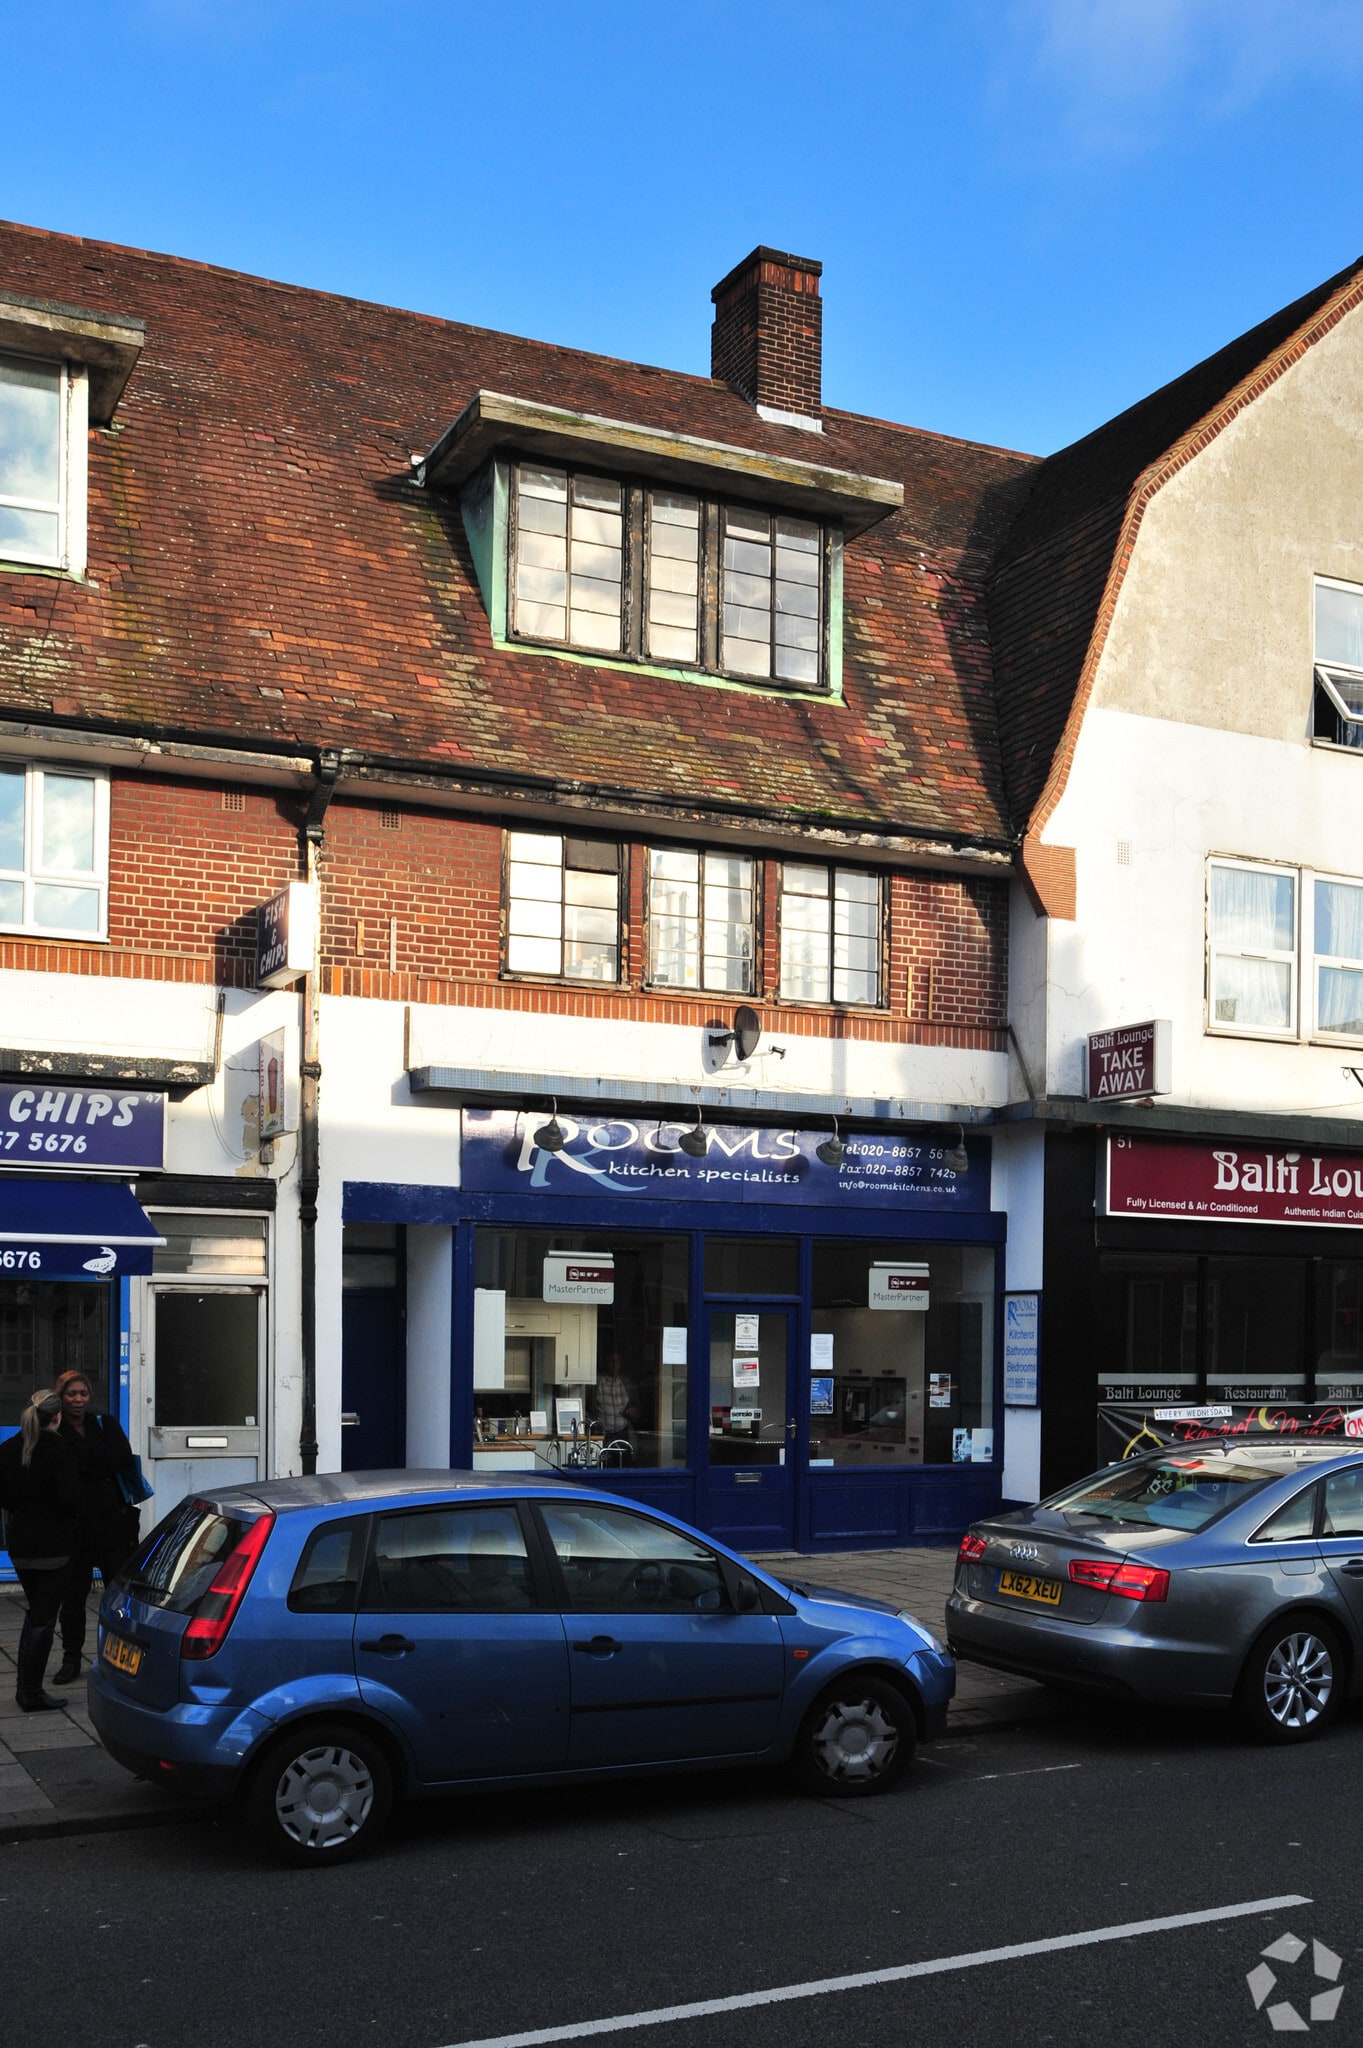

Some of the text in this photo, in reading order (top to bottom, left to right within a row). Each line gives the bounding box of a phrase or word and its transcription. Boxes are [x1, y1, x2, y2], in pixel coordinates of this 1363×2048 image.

[265, 896, 286, 928] FISH
[271, 928, 277, 946] &
[260, 939, 287, 975] CHIPS
[1091, 1028, 1154, 1050] Balti Lounge
[1101, 1047, 1144, 1073] TAKE
[1098, 1068, 1146, 1096] AWAY
[146, 1094, 163, 1105] 47
[9, 1090, 140, 1127] CHIPS
[0, 1131, 87, 1154] 7 5676
[517, 1116, 801, 1176] ROOMS
[1117, 1136, 1133, 1149] 51
[609, 1161, 800, 1184] kitchen specialists
[930, 1167, 957, 1179] 7425
[1212, 1151, 1300, 1194] Balti
[839, 1180, 957, 1194] info@roomskitchens.co.uk
[1126, 1197, 1259, 1213] Fully Licensed & Air Conditioned
[1284, 1206, 1320, 1217] Authentic
[1322, 1208, 1345, 1218] Indian
[0, 1251, 41, 1269] 676
[549, 1284, 608, 1295] MasterPartner
[873, 1292, 925, 1302] MasterPartner
[1009, 1329, 1035, 1340] Kitchens
[1006, 1345, 1037, 1356] Bathrooms
[1006, 1361, 1036, 1372] Bedrooms
[1106, 1387, 1182, 1401] Balti Lounge
[1224, 1387, 1288, 1399] Restaurant
[1328, 1386, 1353, 1398] Balti
[1160, 1407, 1227, 1419] EVERY WEDNESDAY
[1001, 1572, 1060, 1600] LX62 XEU
